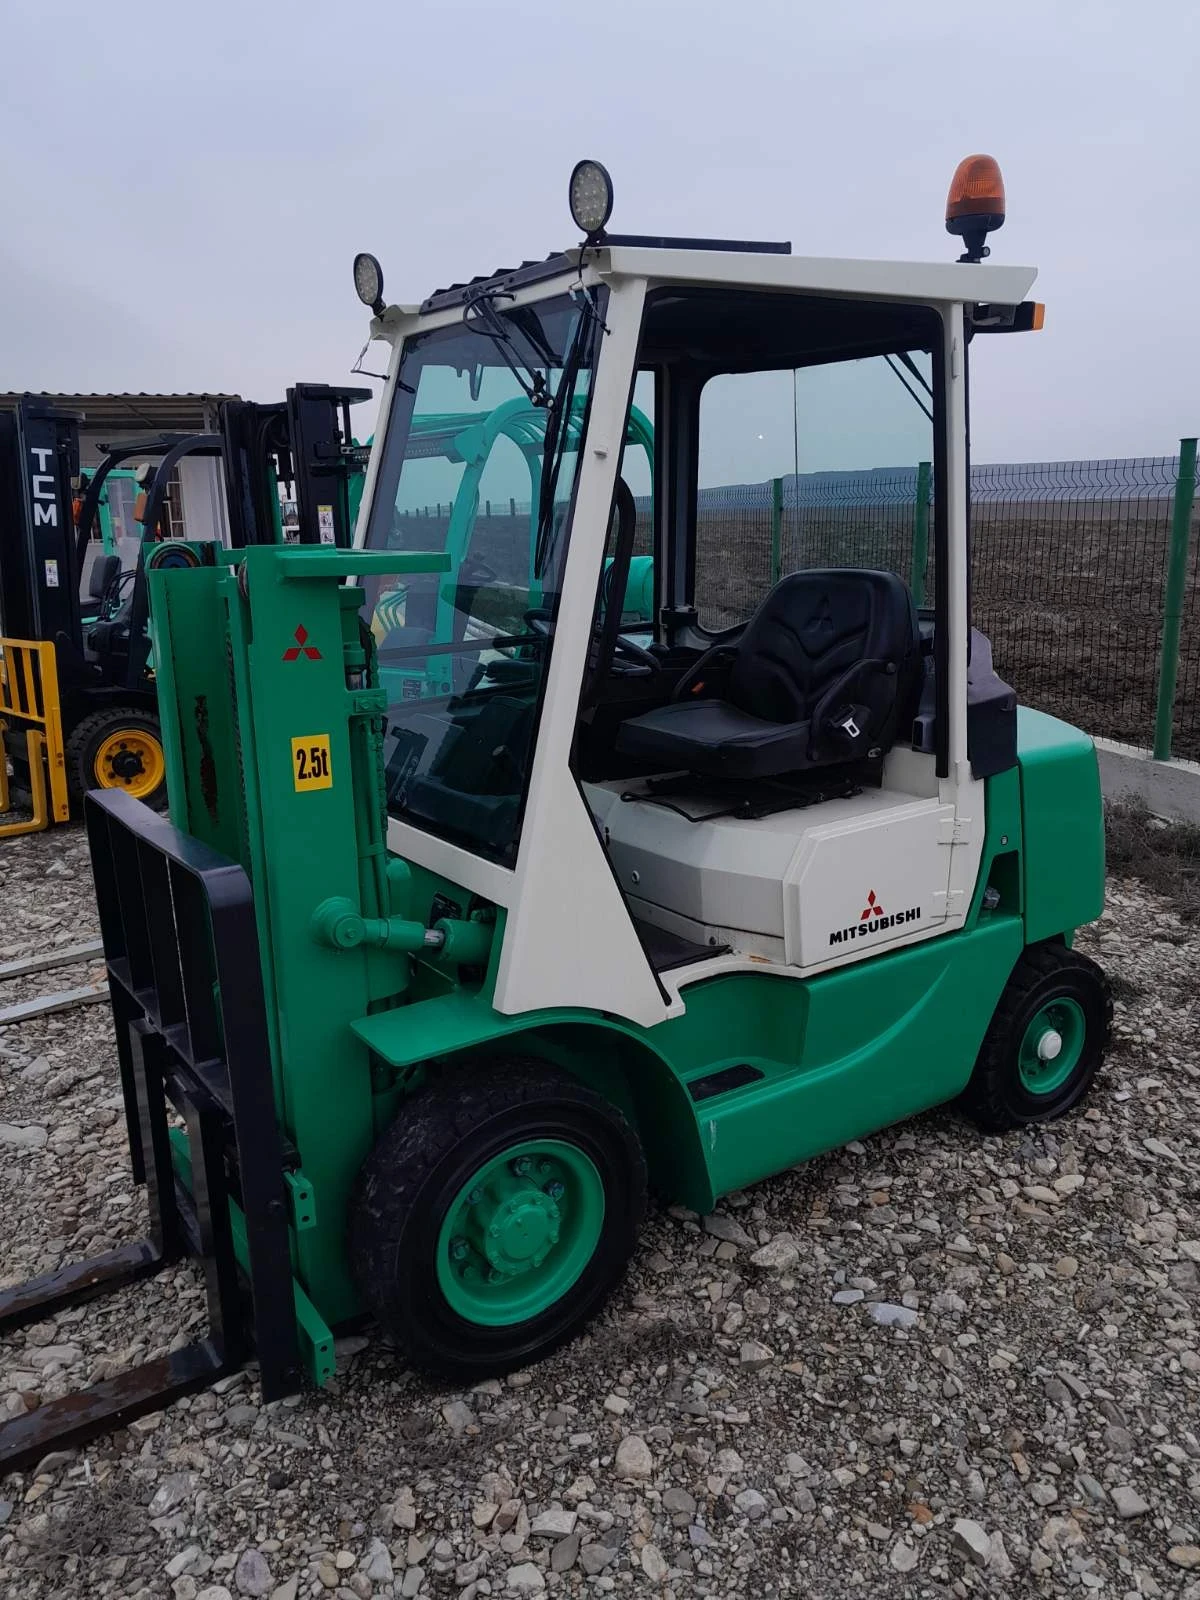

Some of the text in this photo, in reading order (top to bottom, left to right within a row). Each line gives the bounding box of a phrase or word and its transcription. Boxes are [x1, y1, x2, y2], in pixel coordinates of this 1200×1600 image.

[30, 447, 58, 527] TCM
[296, 747, 329, 780] 2.5t
[829, 906, 921, 946] MITSUBISHI
